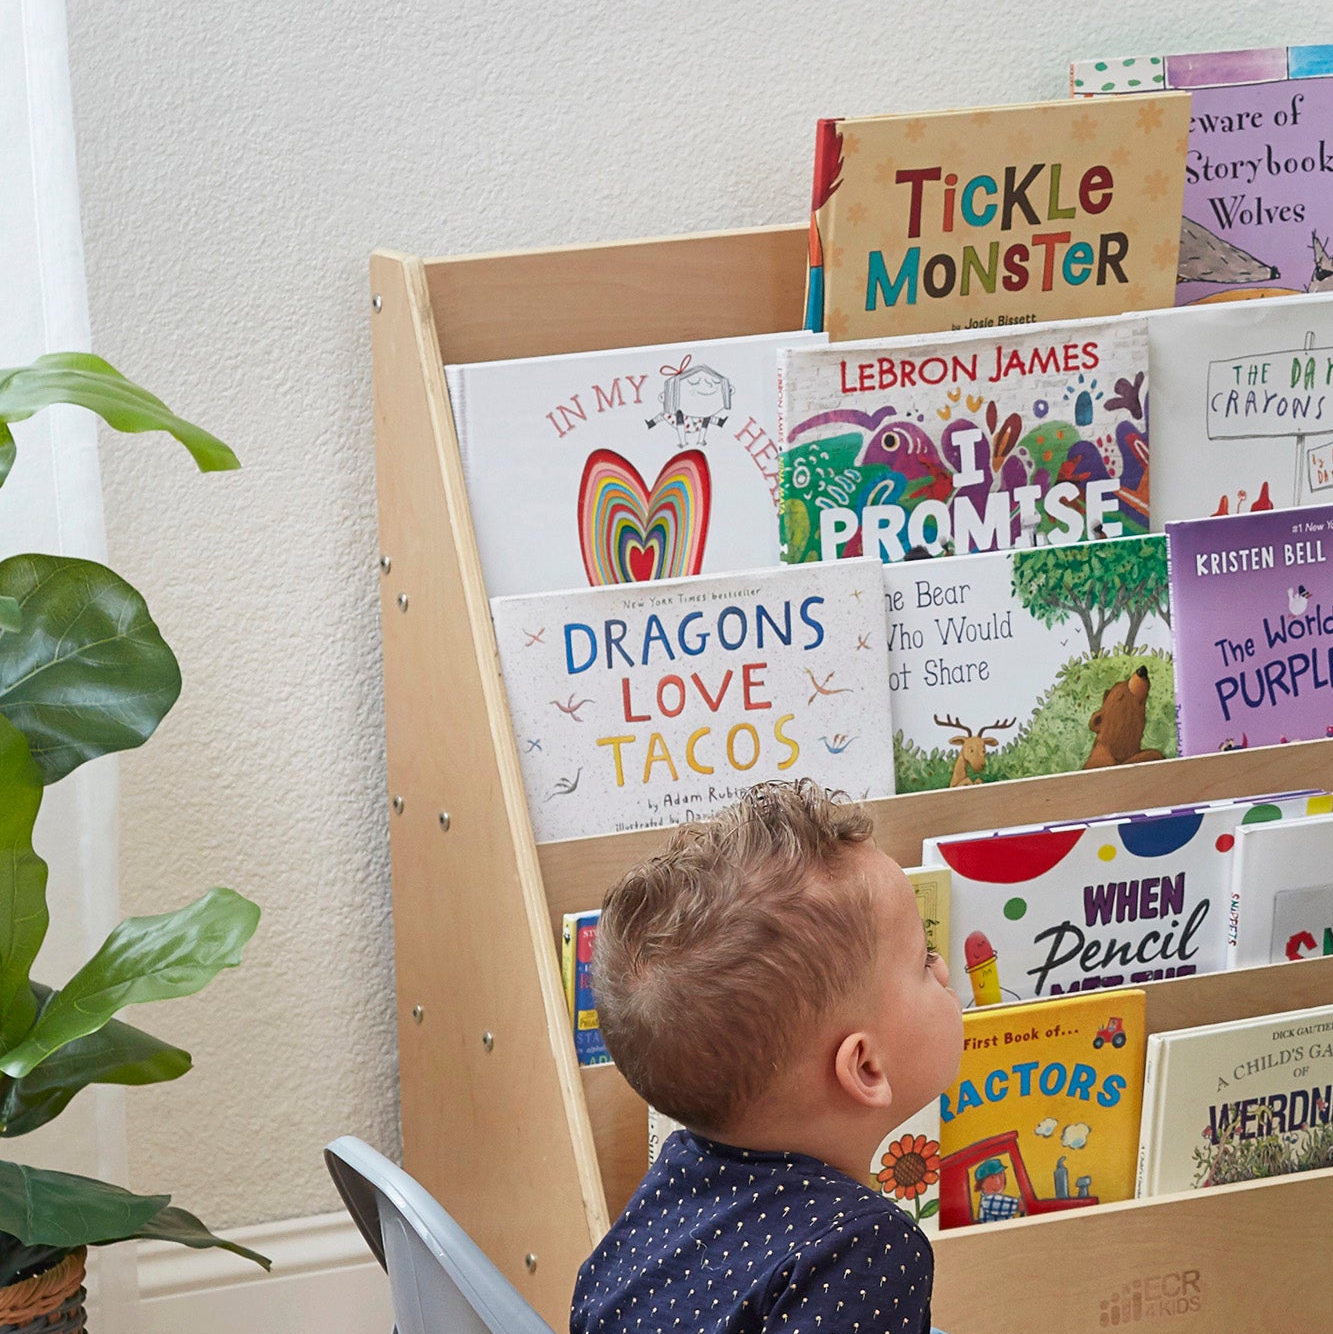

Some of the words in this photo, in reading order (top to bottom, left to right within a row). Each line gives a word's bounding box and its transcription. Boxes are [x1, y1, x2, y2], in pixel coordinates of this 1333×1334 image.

[1274, 93, 1304, 126] of
[1208, 194, 1305, 230] Wolves
[965, 317, 994, 330] Josie
[998, 313, 1037, 327] Bissett
[840, 354, 978, 394] LEBRON
[988, 342, 1100, 383] JAMES
[1232, 363, 1271, 386] THE
[546, 394, 587, 439] IN
[592, 375, 648, 413] MY
[1211, 389, 1325, 420] CRAYONS
[951, 429, 985, 488] I
[820, 478, 1123, 563] PROMISE
[1292, 524, 1303, 534] #1
[1305, 522, 1324, 533] New
[1196, 546, 1274, 577] KRISTEN
[1284, 541, 1326, 566] BELL
[711, 588, 761, 601] bestseller
[915, 580, 971, 608] Bear
[564, 596, 825, 675] DRAGONS
[934, 611, 1013, 645] Would
[1215, 637, 1255, 667] The
[888, 663, 911, 692] ot
[924, 659, 990, 686] Share
[622, 662, 772, 723] LOVE
[596, 713, 800, 787] TACOS
[648, 799, 658, 813] by
[663, 793, 702, 807] Adam
[1084, 872, 1186, 927] WHEN
[1027, 898, 1210, 996] Pencil
[963, 1036, 998, 1051] First
[1004, 1028, 1039, 1045] Book
[1272, 1028, 1295, 1040] DICK
[1216, 1077, 1229, 1093] A
[1233, 1046, 1304, 1081] CHILD'S
[1293, 1067, 1309, 1078] OF
[1144, 1270, 1201, 1301] ECR
